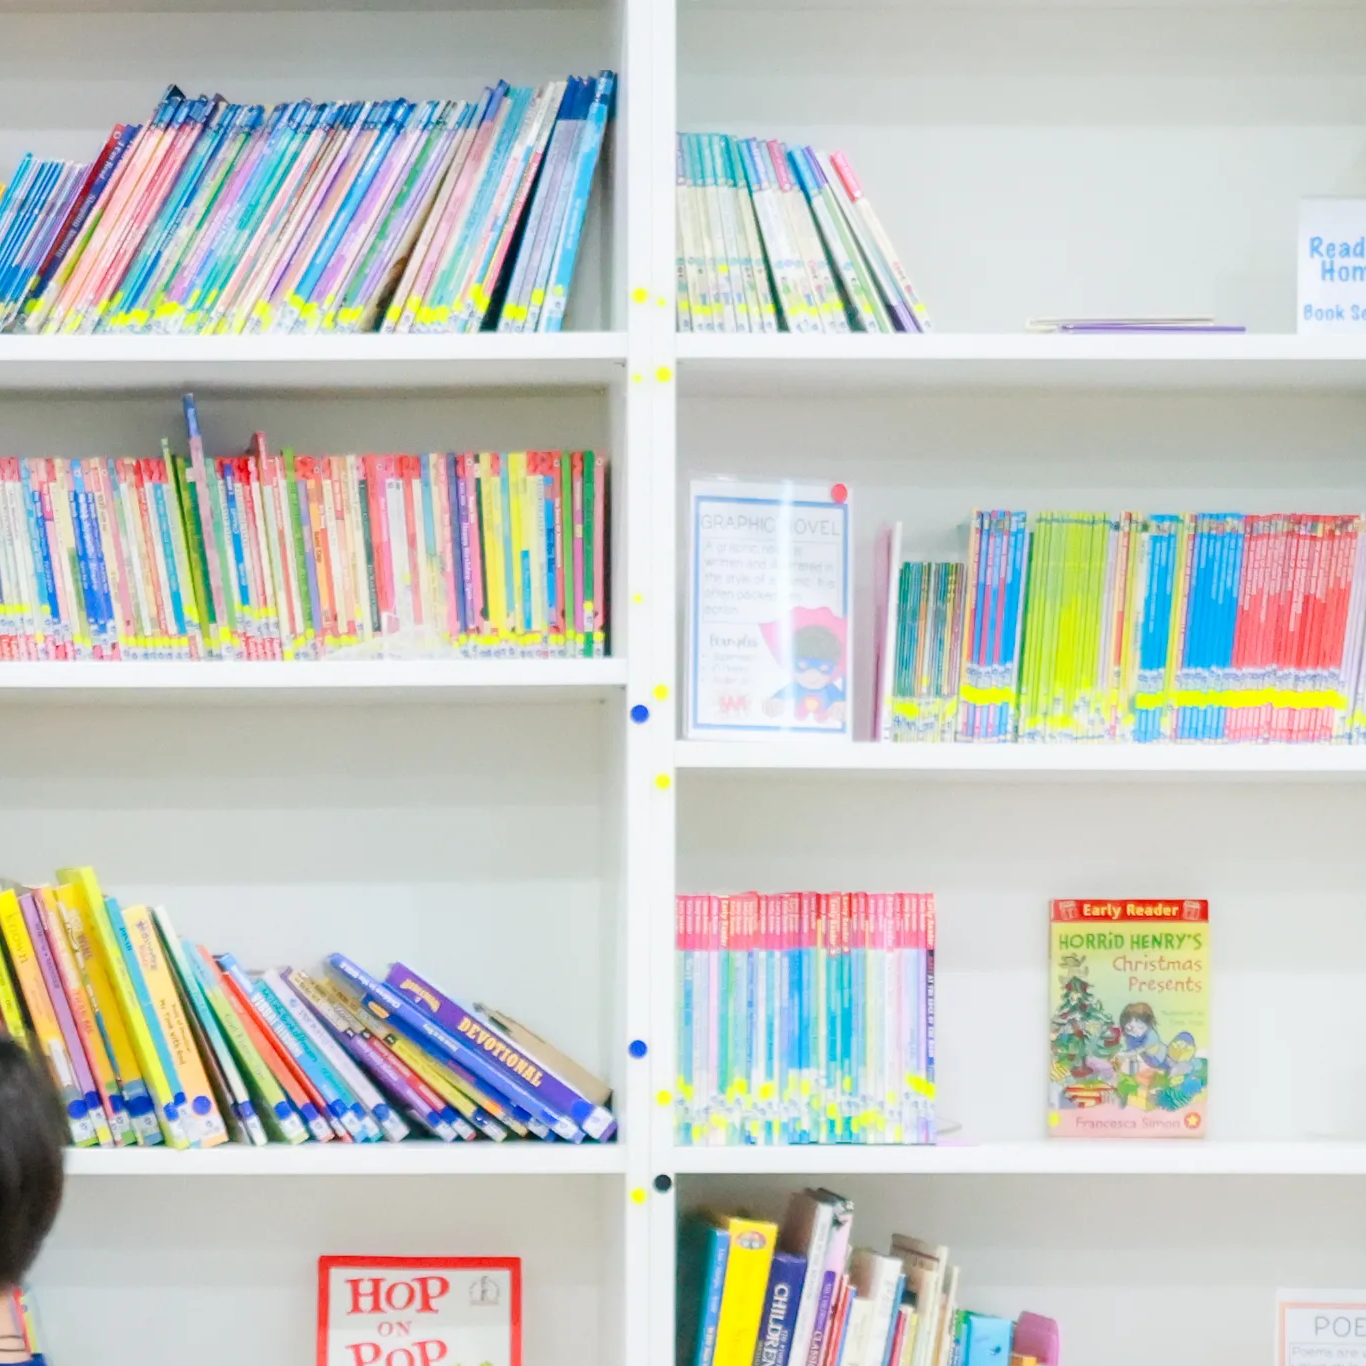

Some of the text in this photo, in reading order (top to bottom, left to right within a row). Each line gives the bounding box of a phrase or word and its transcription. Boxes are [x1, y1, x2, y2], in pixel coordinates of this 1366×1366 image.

[1310, 236, 1365, 259] Read
[1304, 304, 1344, 320] Book
[700, 514, 776, 534] GRAPHIC
[1082, 903, 1180, 920] Early Reader
[1130, 931, 1203, 951] HENRY'S
[1112, 956, 1203, 973] Christmas
[1128, 976, 1203, 993] Presents
[457, 1016, 543, 1088] DEVOTIONAL
[1075, 1116, 1181, 1130] Francesca Simon
[345, 1274, 450, 1316] HOP
[376, 1320, 413, 1338] ON
